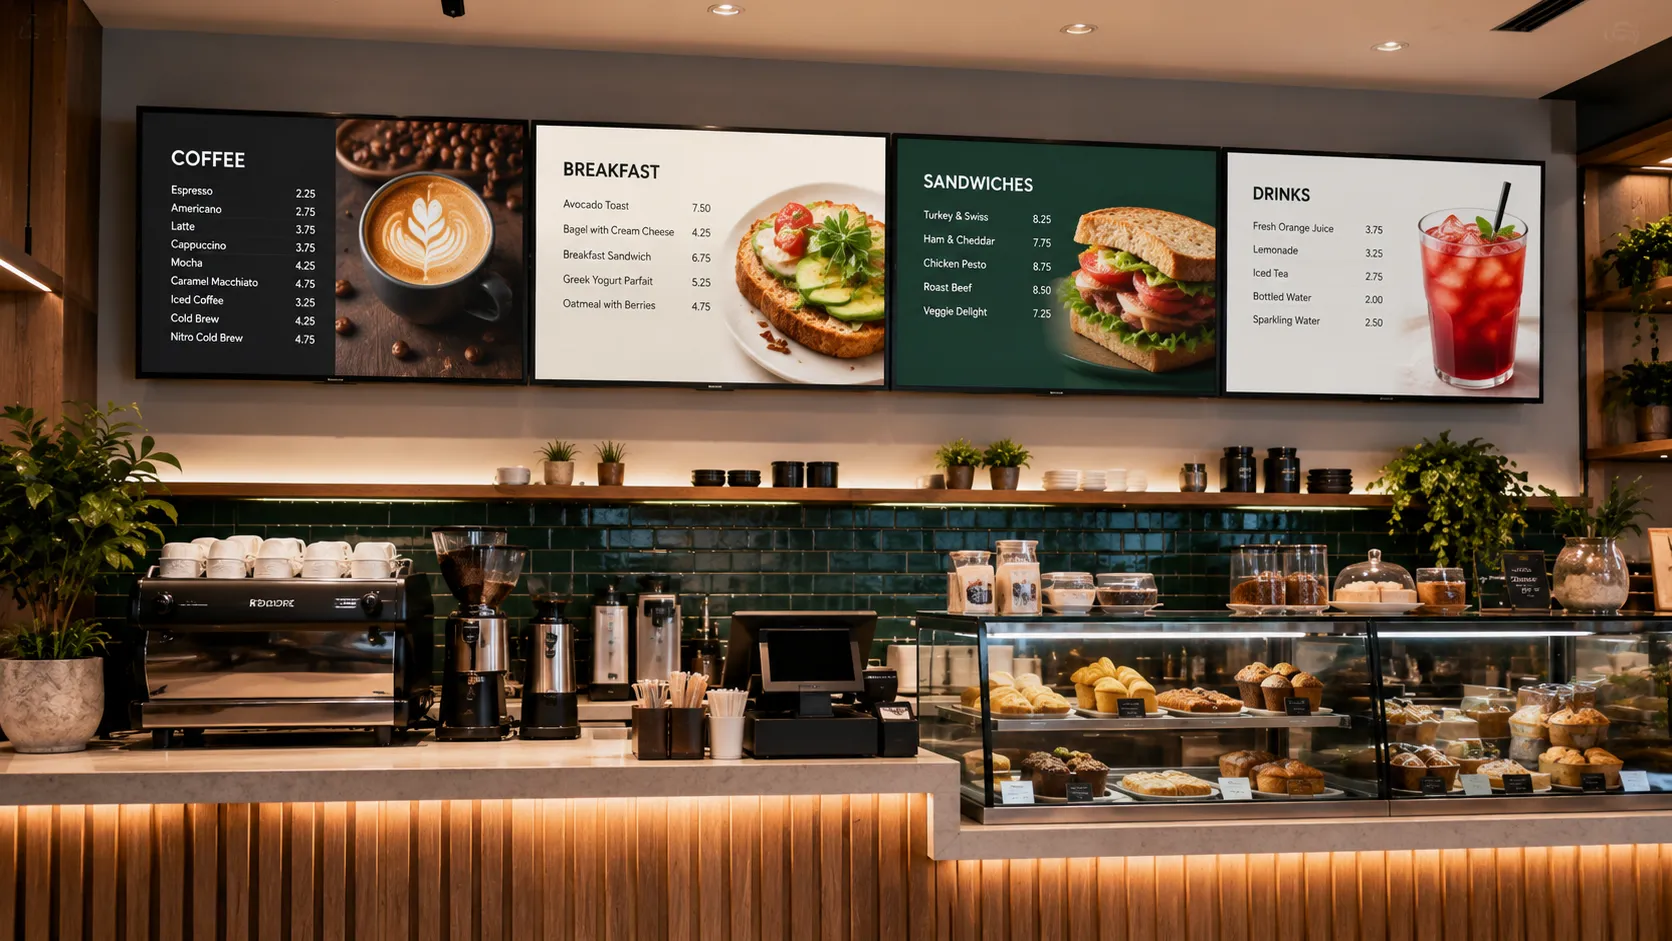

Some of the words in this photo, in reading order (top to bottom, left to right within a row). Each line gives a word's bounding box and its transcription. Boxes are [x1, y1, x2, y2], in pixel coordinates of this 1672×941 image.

[171, 150, 245, 168] COFFEE
[563, 162, 660, 179] BREAKFAST
[923, 174, 1033, 192] SANDWICHES
[171, 185, 213, 196] Espresso
[295, 189, 315, 198] 2.25
[1253, 186, 1310, 202] DRINKS
[170, 203, 222, 213] Americano
[295, 207, 315, 216] 2.75
[562, 199, 603, 209] Avocado
[604, 201, 629, 210] Toast
[692, 203, 711, 212] 7.50
[923, 210, 953, 222] Turkey
[955, 211, 962, 220] &
[964, 212, 988, 221] Swiss
[1032, 215, 1051, 223] 8.25
[171, 221, 195, 231] Latte
[295, 225, 315, 234] 3.75
[563, 224, 587, 236] Bagel
[589, 226, 608, 234] with
[610, 226, 640, 235] Cream
[641, 227, 674, 236] Cheese
[691, 228, 711, 237] 4.25
[1252, 222, 1276, 230] Fresh
[1278, 223, 1310, 234] Orange
[1311, 224, 1334, 233] Juice
[1365, 225, 1383, 234] 3.75
[170, 239, 226, 251] Cappuccino
[295, 243, 315, 252] 3.75
[923, 235, 944, 243] Ham
[947, 235, 953, 244] &
[955, 235, 995, 245] Cheddar
[1032, 238, 1051, 247] 7.75
[563, 250, 605, 260] Breakfast
[607, 251, 651, 261] Sandwich
[691, 253, 711, 262] 6.75
[1252, 245, 1298, 255] Lemonade
[1365, 249, 1383, 258] 3.25
[170, 258, 202, 267] Mocha
[295, 261, 315, 270] 4.25
[923, 258, 959, 268] Chicken
[961, 260, 986, 269] Pesto
[1032, 262, 1051, 271] 8.75
[562, 274, 590, 284] Greek
[591, 276, 621, 287] Yogurt
[624, 276, 653, 285] Parfait
[691, 278, 711, 287] 5.25
[1252, 269, 1271, 277] Iced
[1273, 269, 1288, 278] Tea
[1365, 272, 1383, 281] 2.75
[170, 276, 208, 285] Caramel
[211, 277, 258, 287] Macchiato
[295, 279, 315, 288] 4.75
[923, 282, 949, 291] Roast
[951, 283, 972, 292] Beef
[1032, 285, 1051, 295] 8.50
[170, 295, 191, 304] Iced
[193, 295, 223, 305] Coffee
[295, 298, 315, 307] 3.25
[1252, 292, 1284, 301] Bottled
[1285, 293, 1312, 301] Water
[1364, 295, 1383, 304] 2.00
[562, 299, 601, 308] Oatmeal
[603, 300, 622, 309] with
[624, 300, 655, 309] Berries
[691, 302, 710, 311] 4.75
[923, 306, 954, 317] Veggie
[955, 307, 987, 318] Delight
[1032, 309, 1051, 318] 7.25
[170, 313, 192, 323] Cold
[195, 314, 219, 323] Brew
[294, 316, 315, 325] 4.25
[1252, 315, 1292, 326] Sparkling
[1294, 316, 1320, 325] Water
[1364, 318, 1383, 327] 2.50
[170, 332, 193, 341] Nitro
[195, 333, 217, 342] Cold
[219, 333, 243, 342] Brew
[294, 335, 315, 344] 4.75
